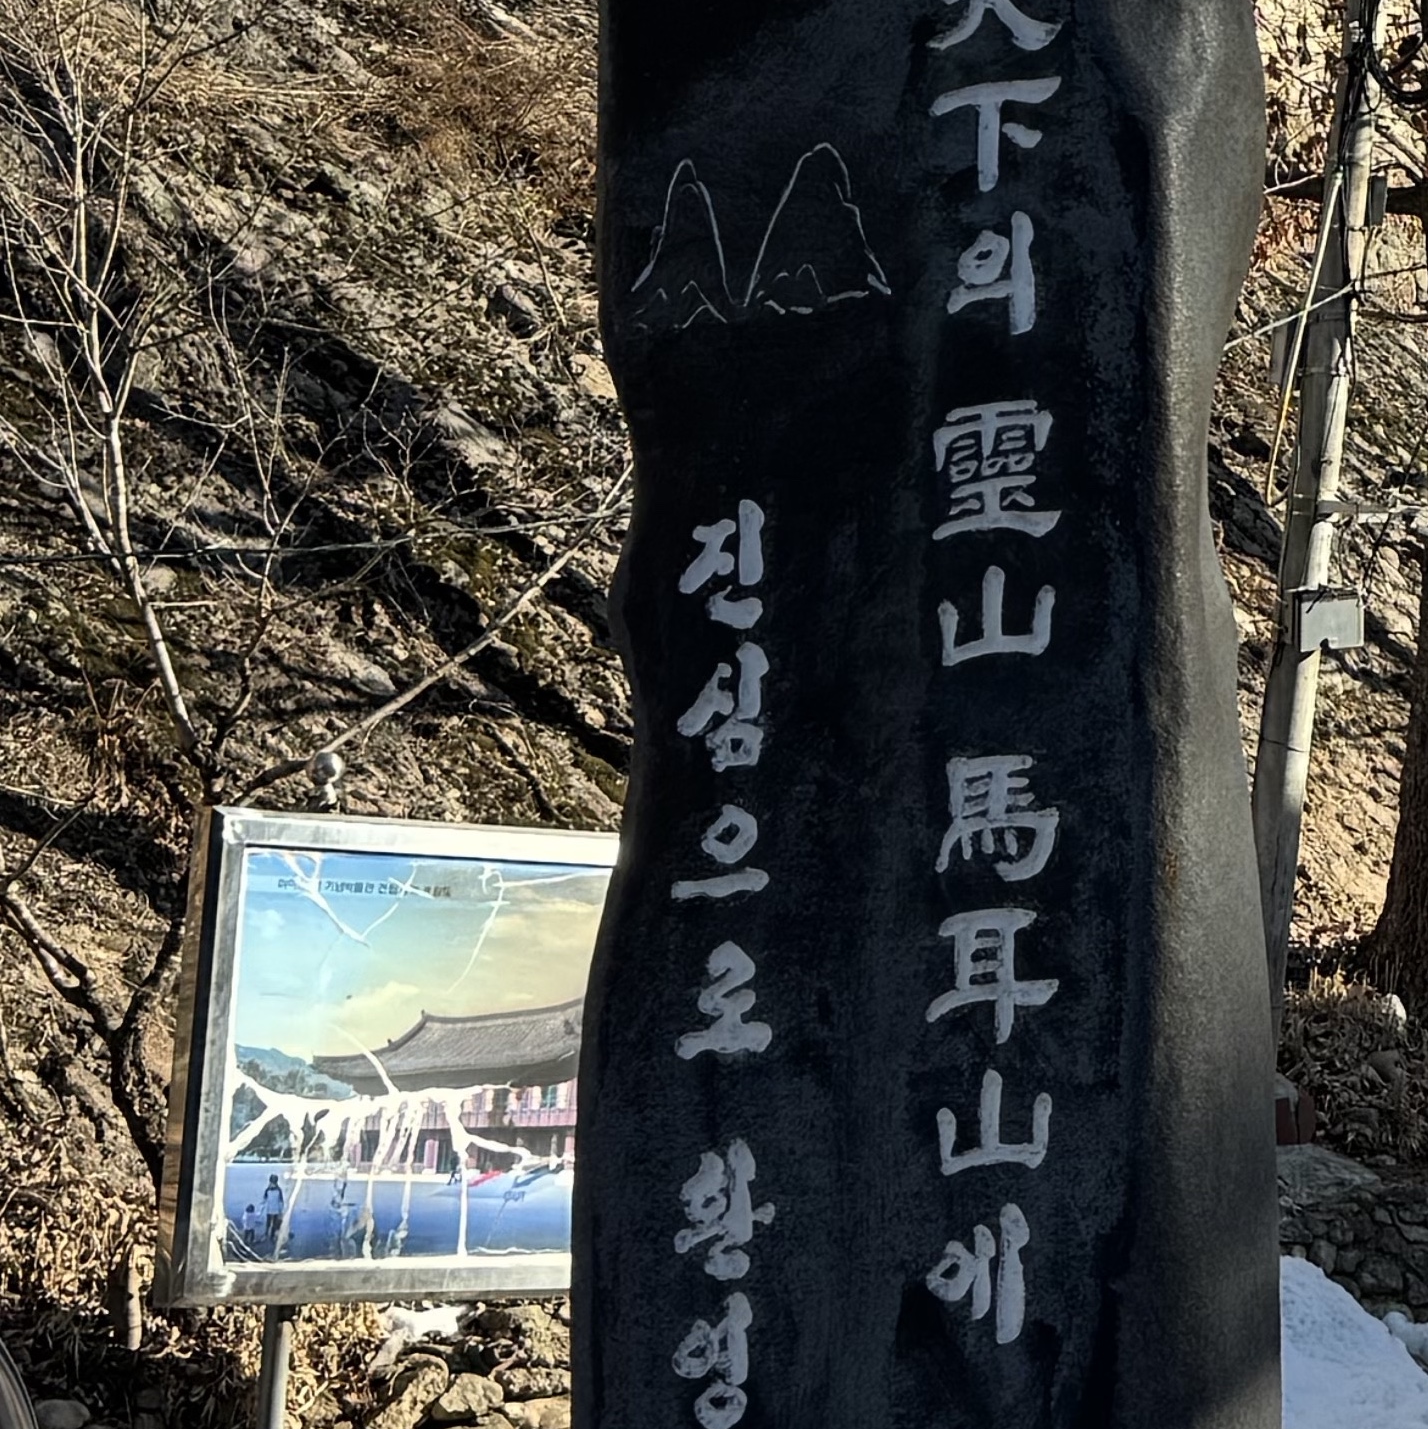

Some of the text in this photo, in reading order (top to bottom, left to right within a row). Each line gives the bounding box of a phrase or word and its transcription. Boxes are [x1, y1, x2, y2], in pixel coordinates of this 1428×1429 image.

[671, 498, 773, 1061] 진심으로
[931, 398, 1064, 669] 靈山
[925, 752, 1062, 1345] 馬耳山에
